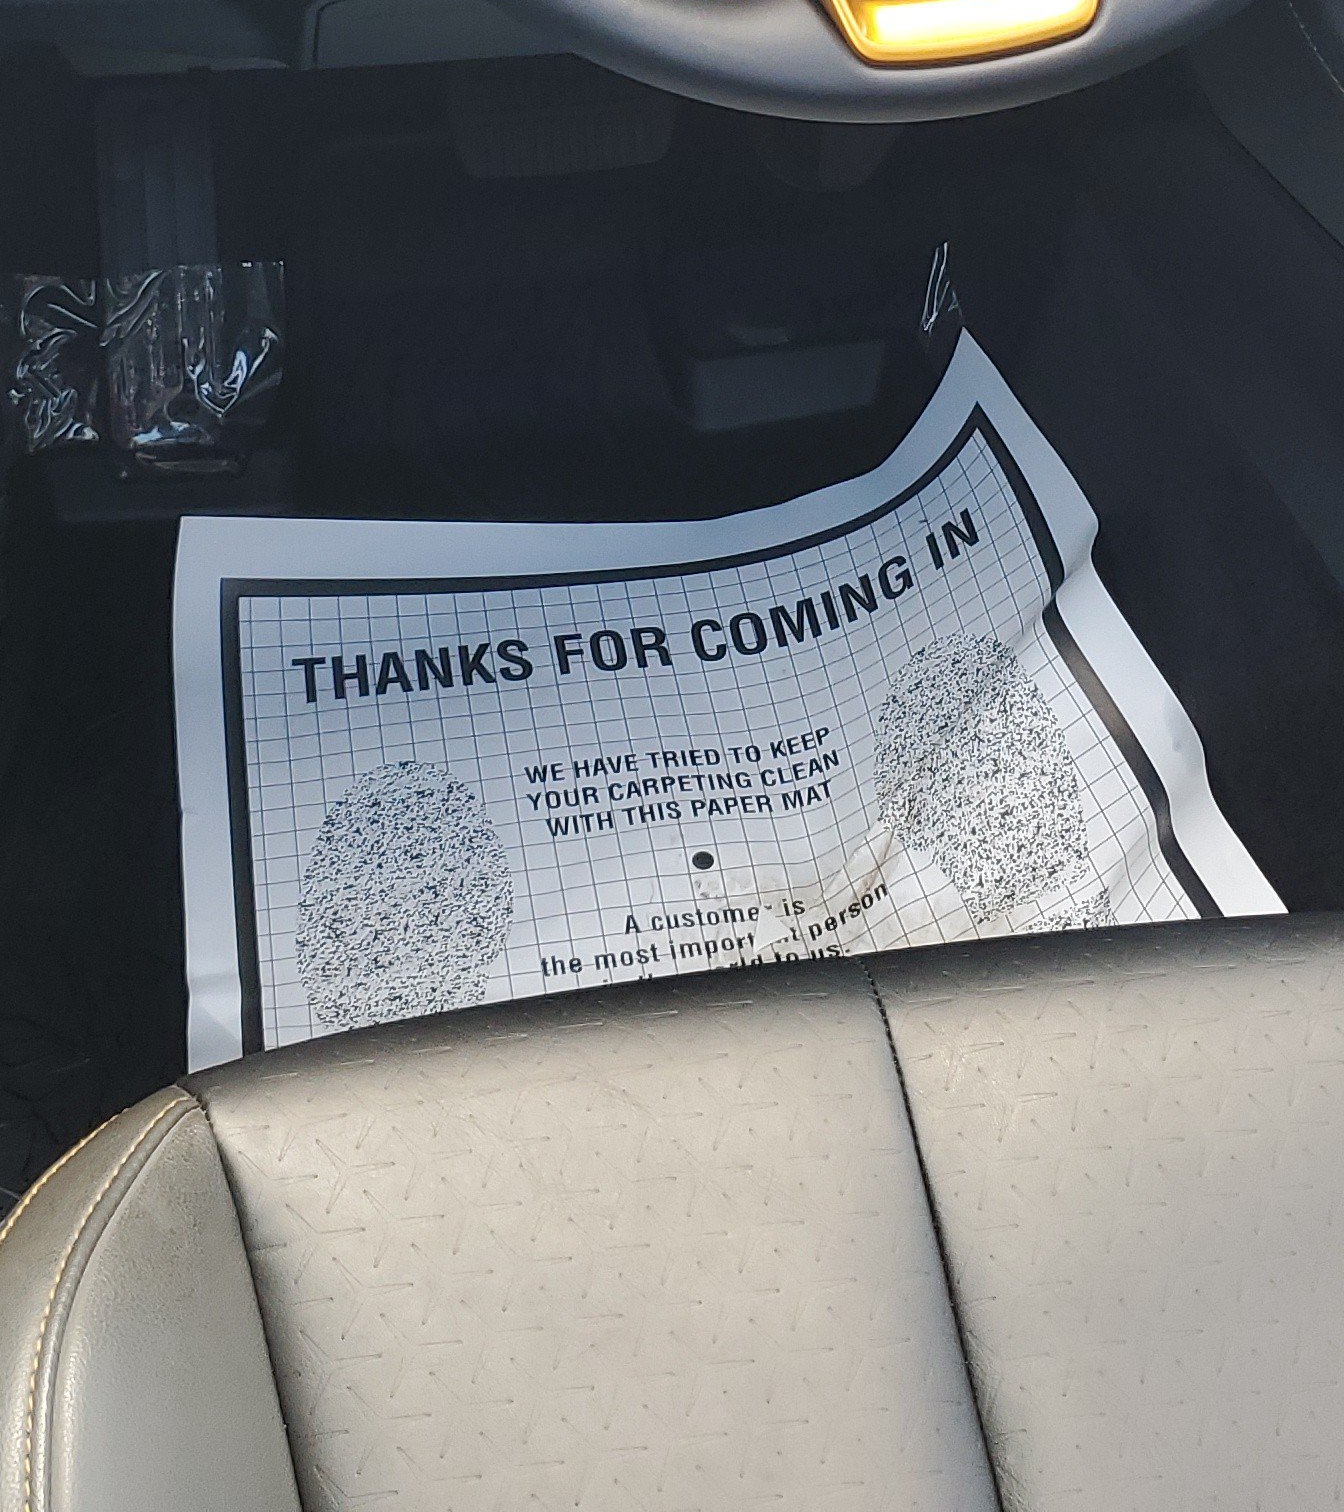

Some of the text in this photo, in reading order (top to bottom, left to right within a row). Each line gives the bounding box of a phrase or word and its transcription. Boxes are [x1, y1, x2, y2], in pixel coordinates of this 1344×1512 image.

[291, 508, 980, 703] THANKS FOR COMING IN
[524, 726, 831, 784] WE HAVE TRIED TO KEEP
[526, 749, 841, 811] YOUR CARPETING CLEAN
[546, 779, 834, 837] WITH THIS PAPER MAT
[540, 956, 584, 977] the
[593, 943, 661, 971] most
[808, 882, 889, 942] person
[624, 898, 806, 935] A custome is
